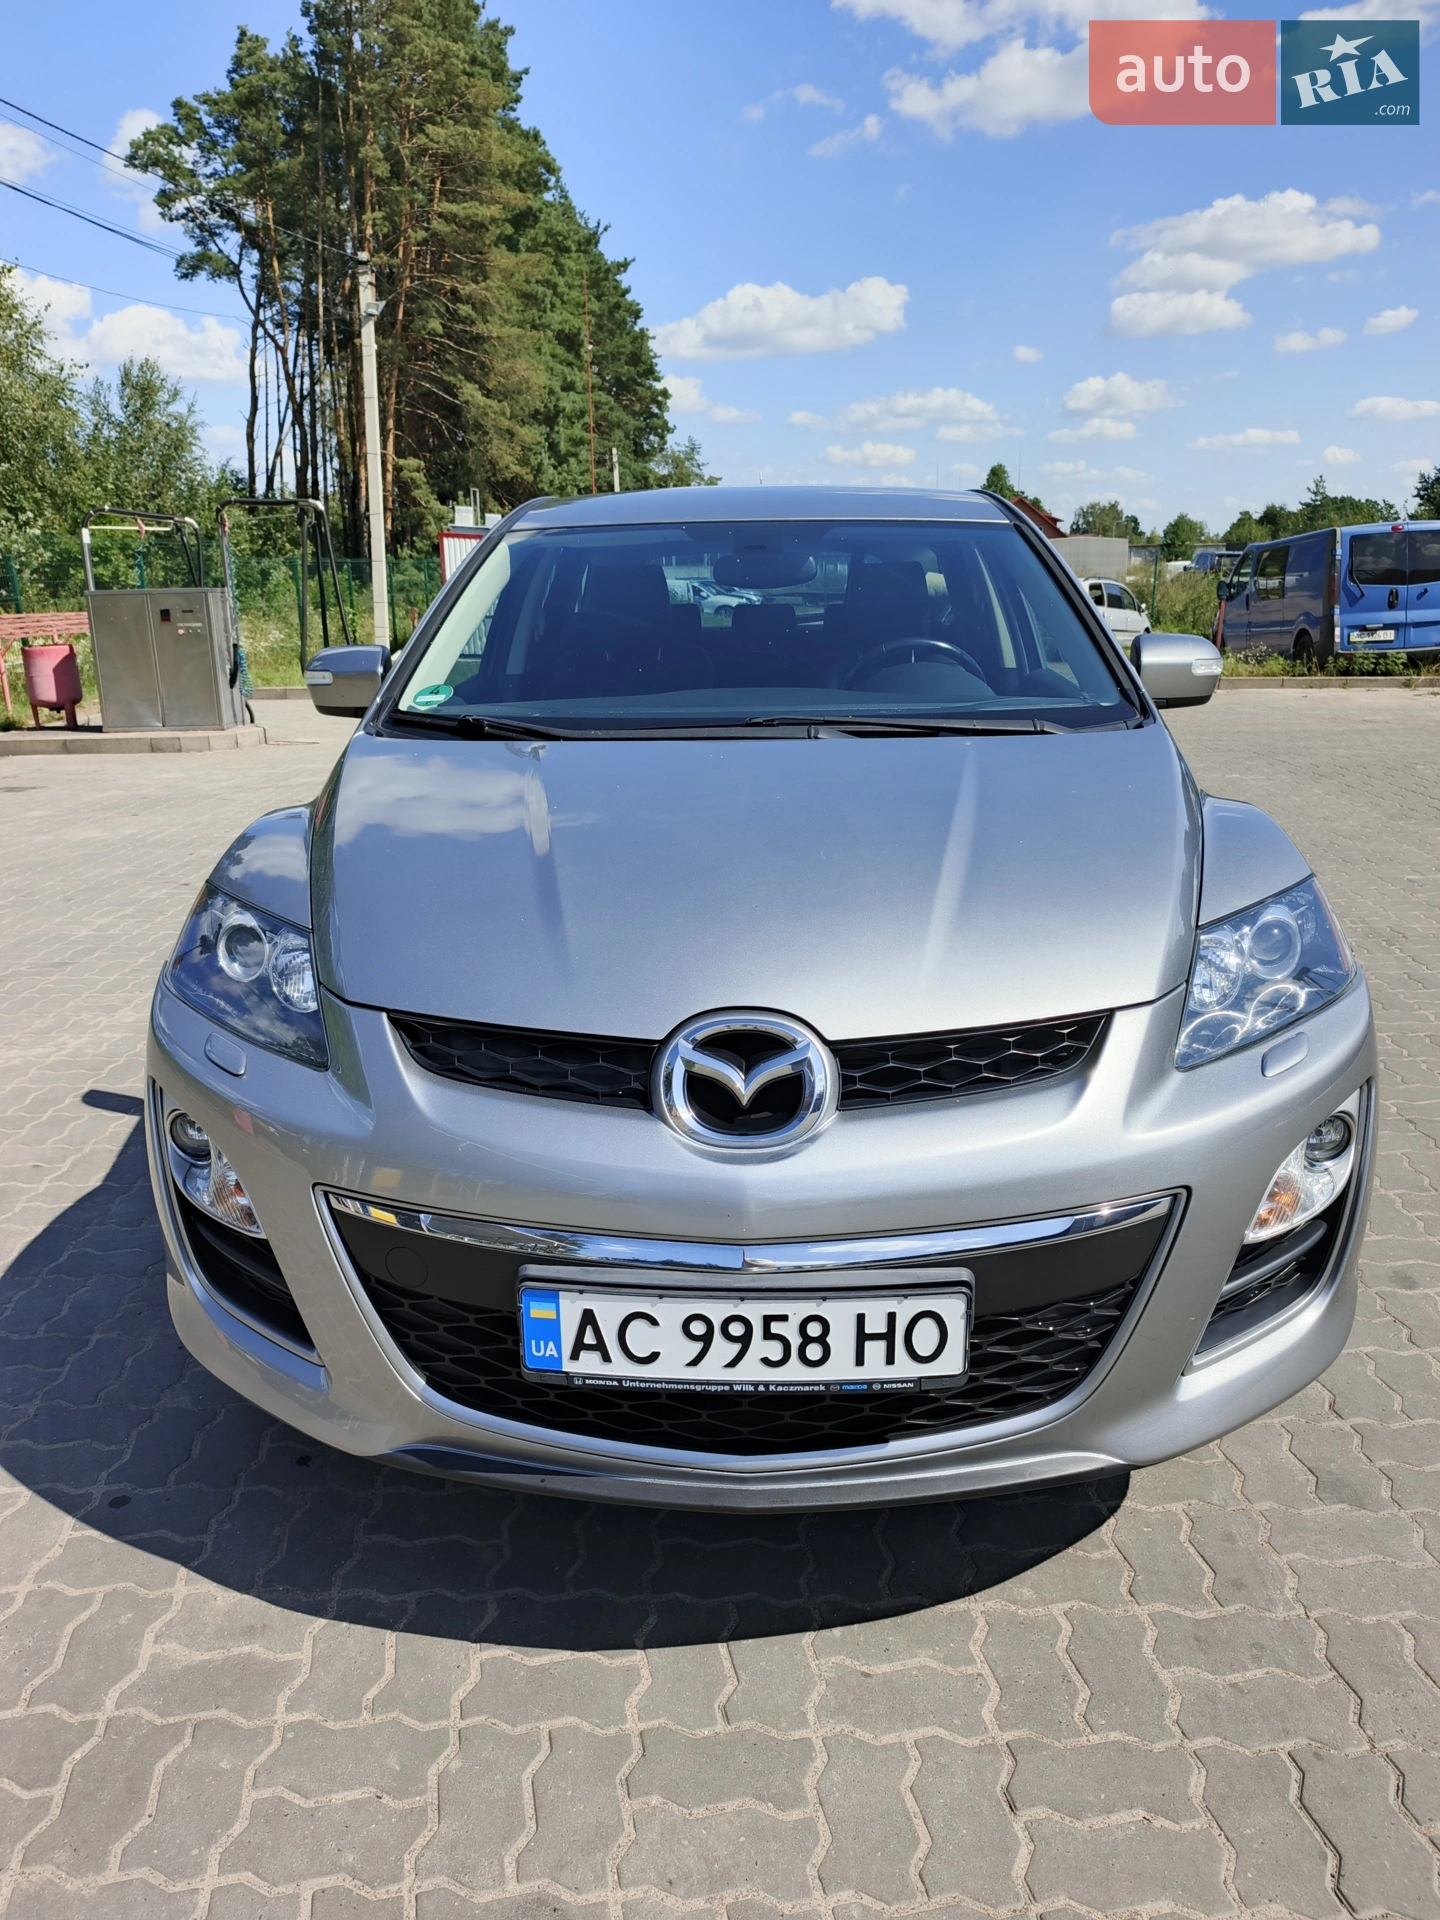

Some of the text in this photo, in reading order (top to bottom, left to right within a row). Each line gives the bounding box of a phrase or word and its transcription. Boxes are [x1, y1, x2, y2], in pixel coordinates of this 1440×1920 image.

[569, 1308, 949, 1368] AC 9958 HO
[531, 1339, 558, 1358] UA
[622, 1379, 730, 1392] Unternehmensgruppe
[733, 1383, 755, 1391] Wilk
